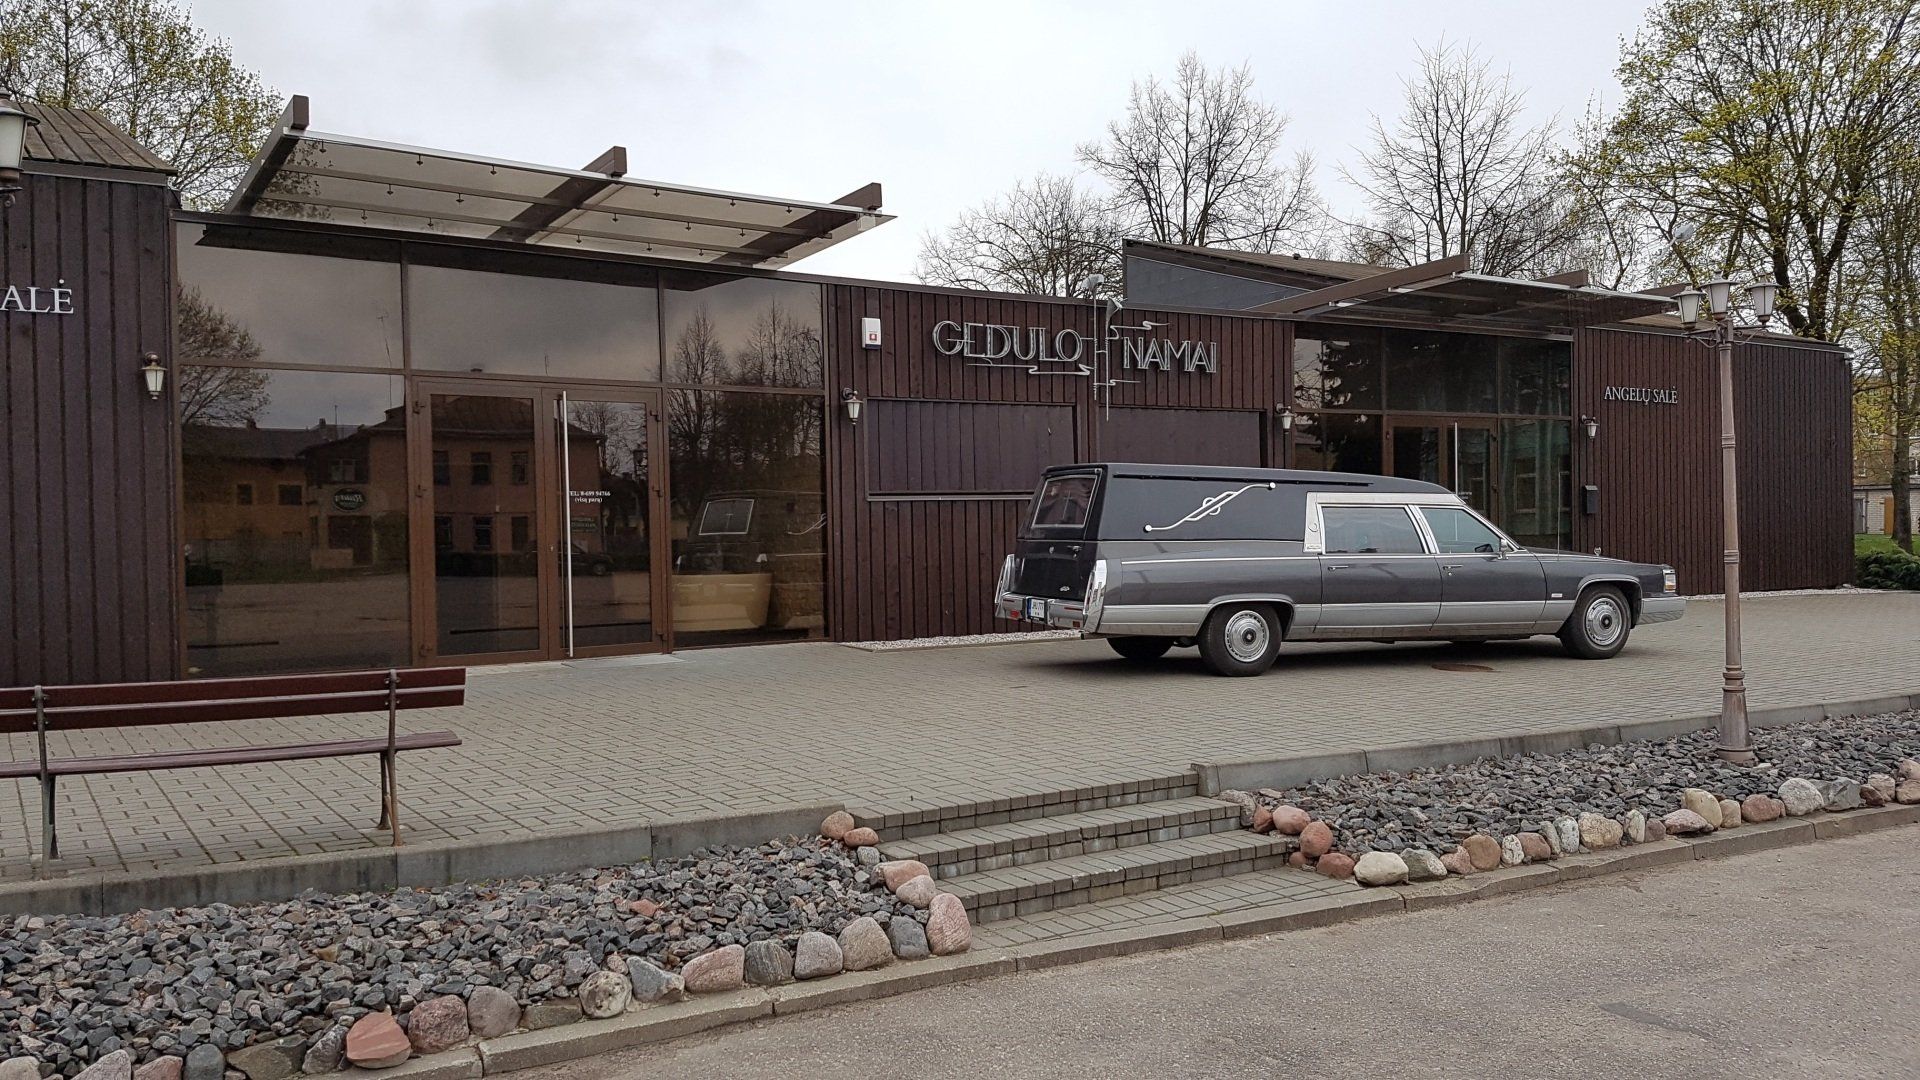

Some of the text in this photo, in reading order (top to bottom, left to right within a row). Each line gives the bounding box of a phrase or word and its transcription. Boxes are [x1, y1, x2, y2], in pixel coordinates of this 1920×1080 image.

[932, 319, 1217, 373] GEDULO NAMAI
[1604, 386, 1678, 405] ANGELŲ SALĖ
